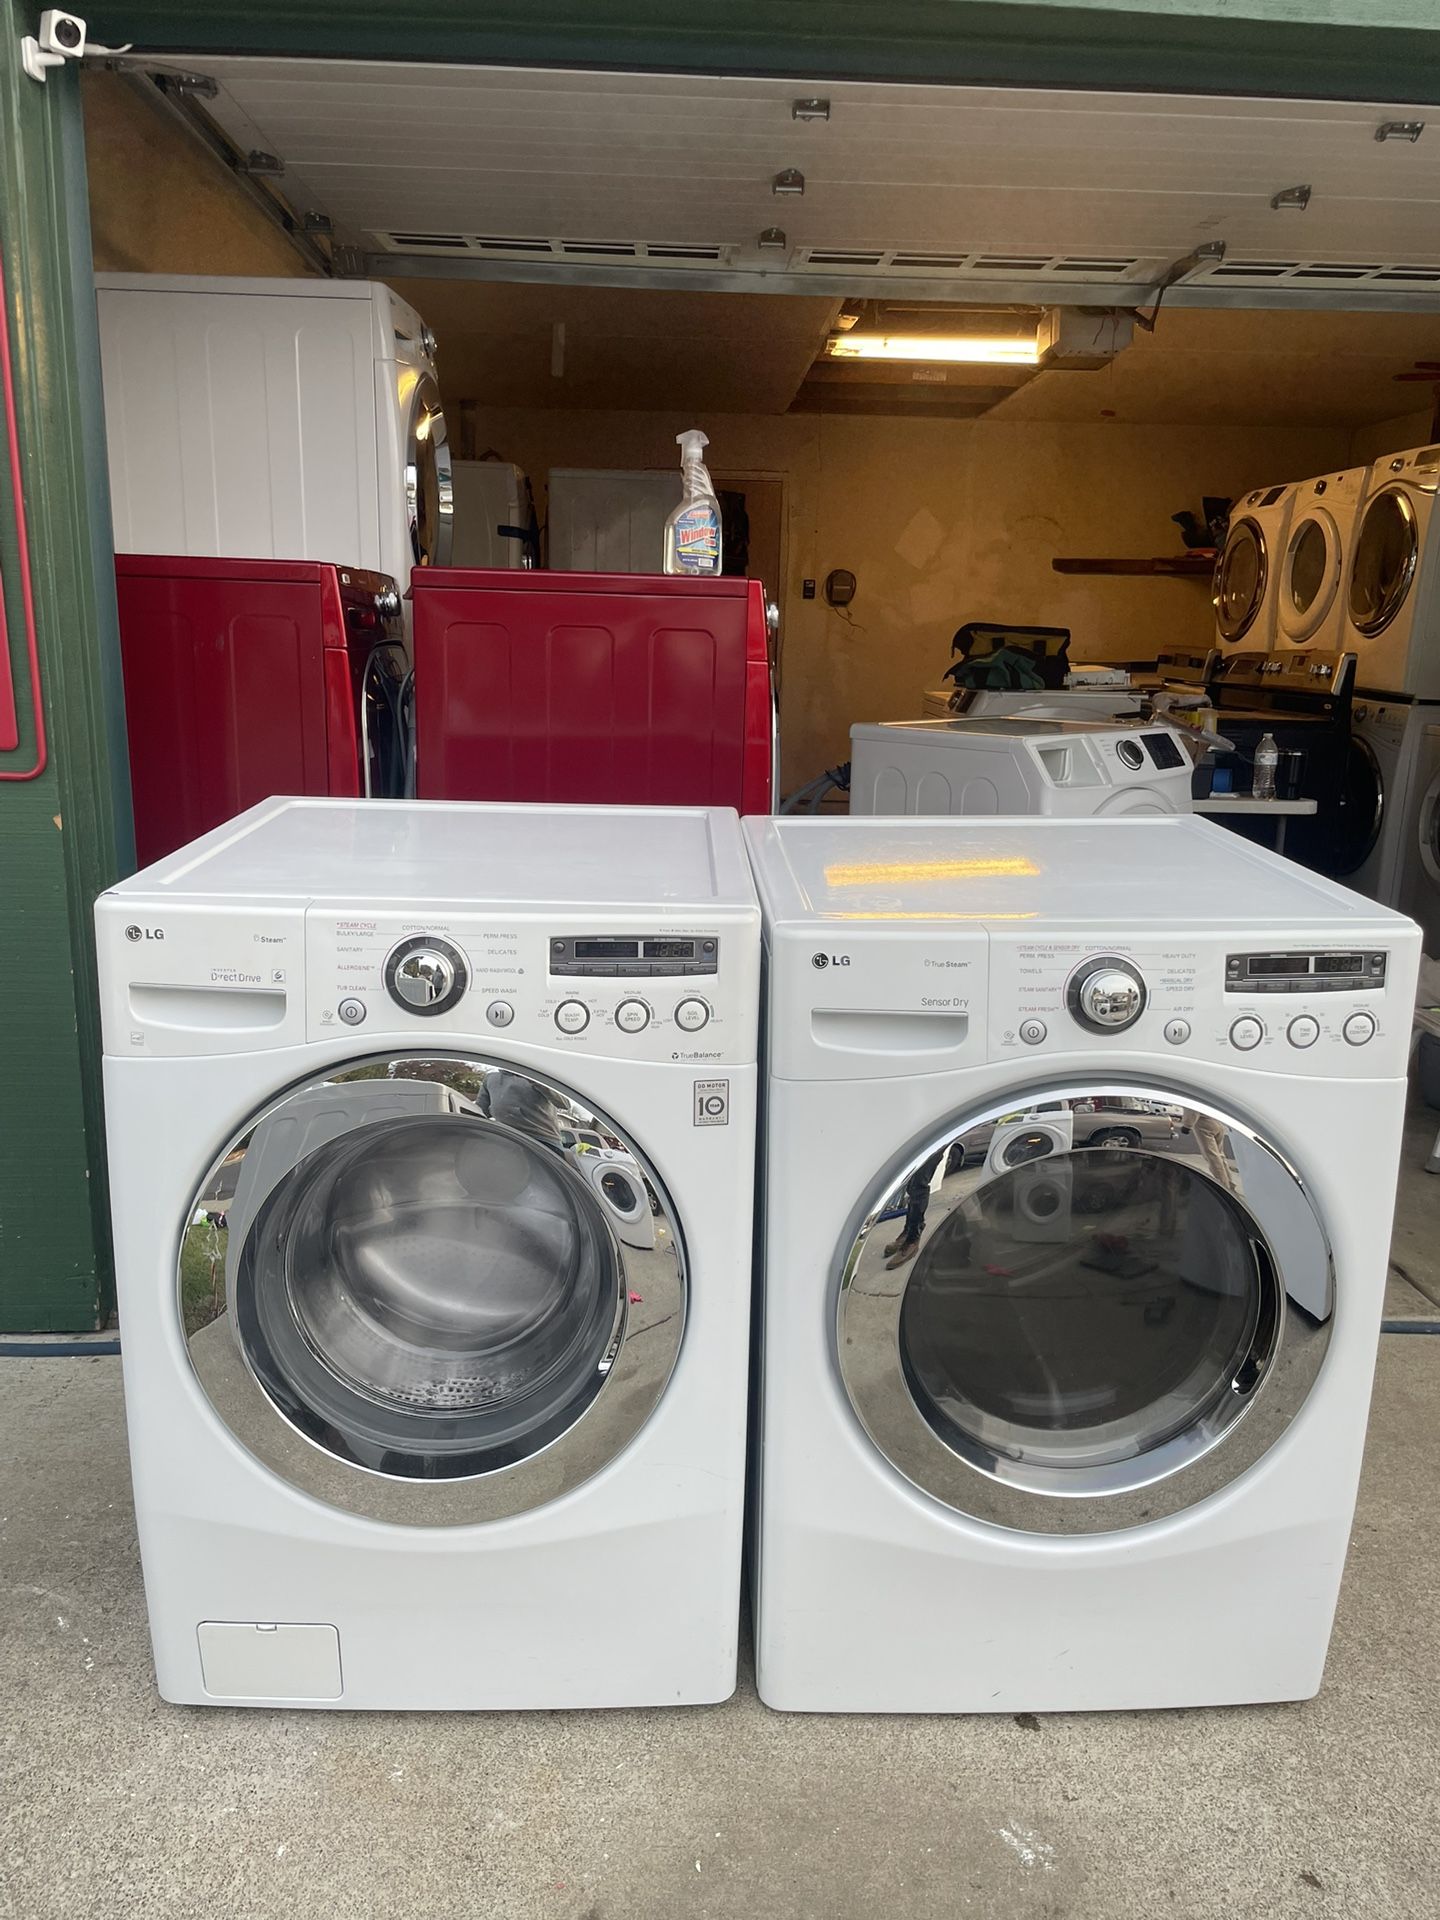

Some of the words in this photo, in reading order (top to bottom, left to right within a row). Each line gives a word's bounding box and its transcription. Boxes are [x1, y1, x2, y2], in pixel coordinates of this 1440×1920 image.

[145, 928, 164, 940] LG
[832, 955, 851, 966] LG
[238, 972, 261, 983] Drive
[921, 997, 951, 1007] Sensor
[952, 997, 969, 1009] Dry
[698, 1095, 725, 1116] 10
